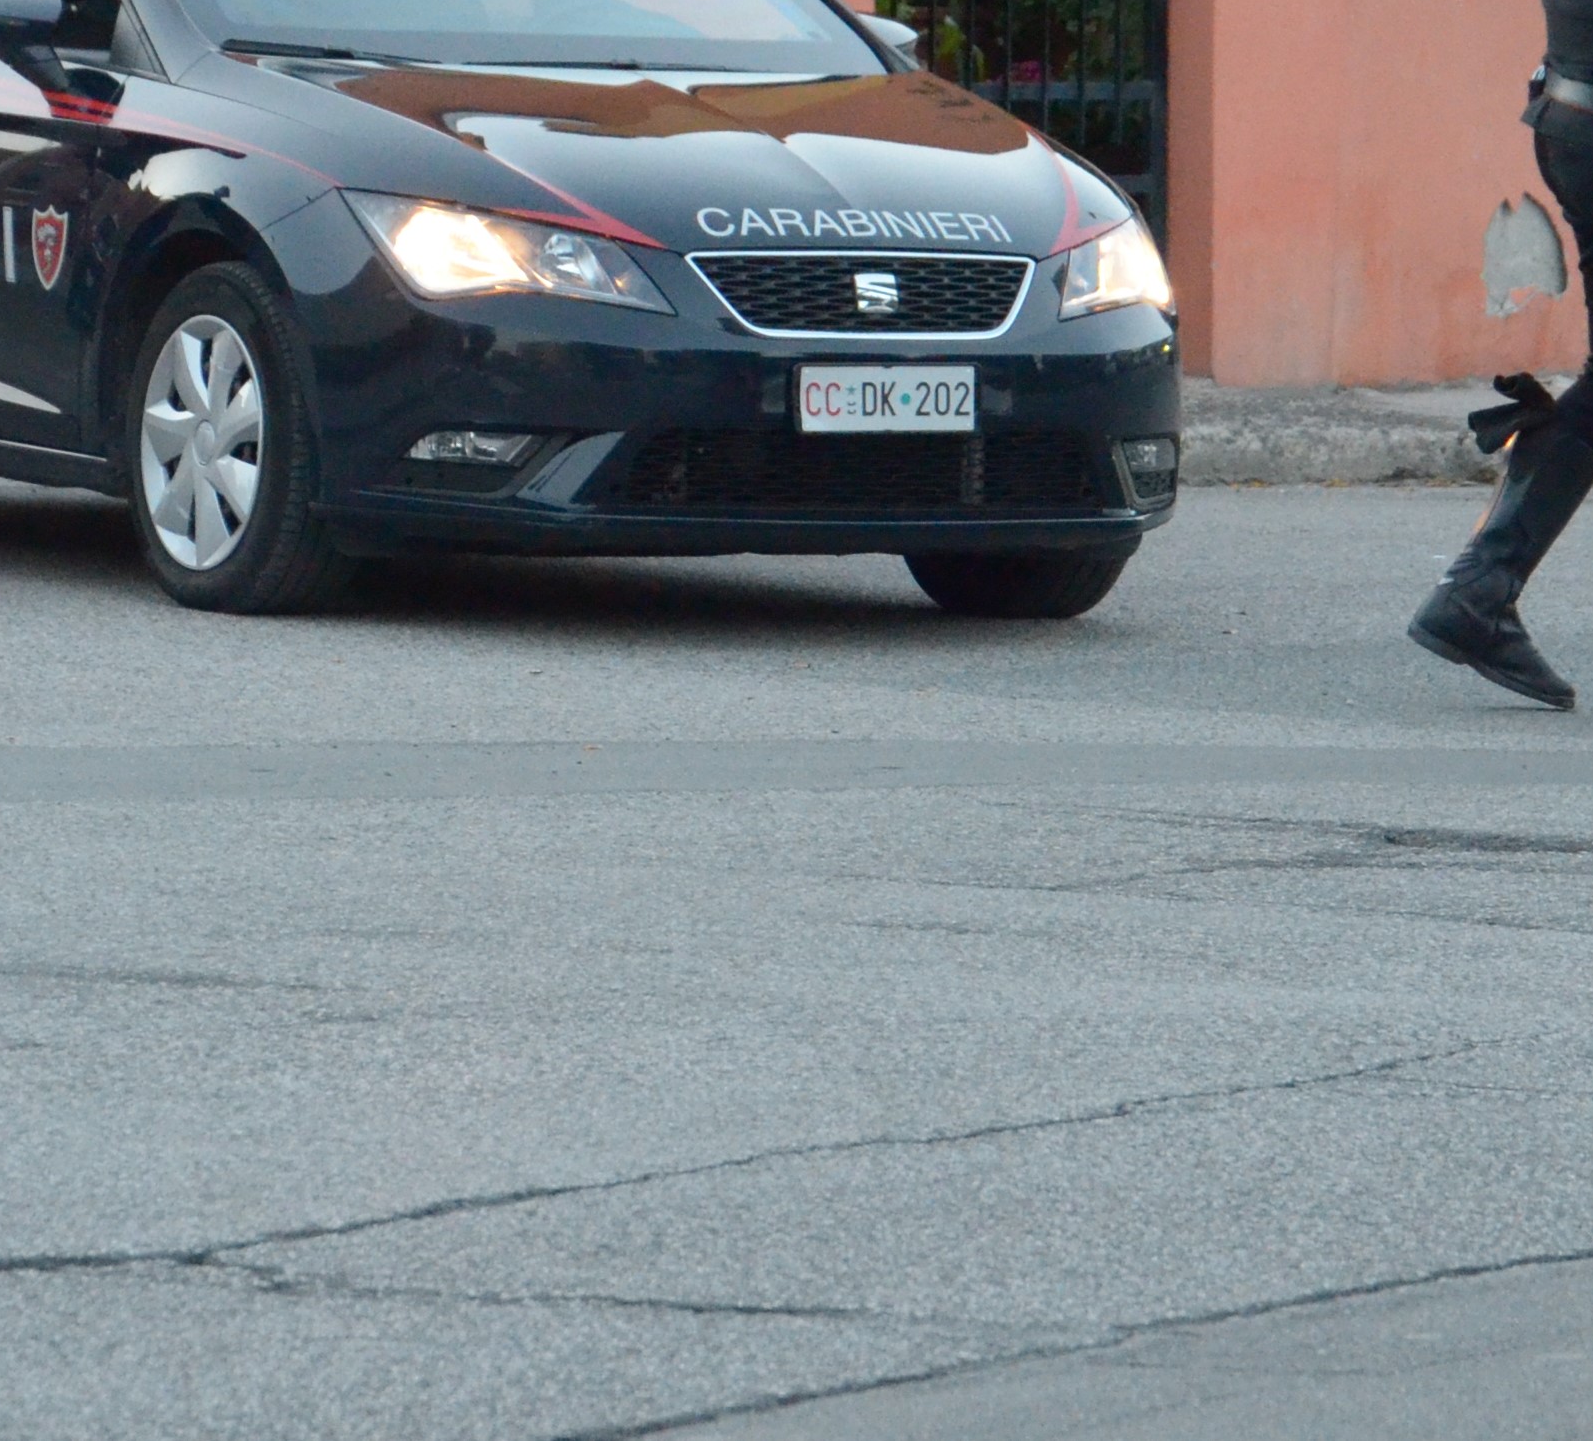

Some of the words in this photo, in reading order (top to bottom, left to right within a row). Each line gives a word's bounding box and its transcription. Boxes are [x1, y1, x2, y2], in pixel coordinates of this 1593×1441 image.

[696, 207, 1012, 242] CARABINIERI
[806, 382, 840, 416] CC
[862, 381, 896, 416] DK
[915, 381, 970, 416] 202
